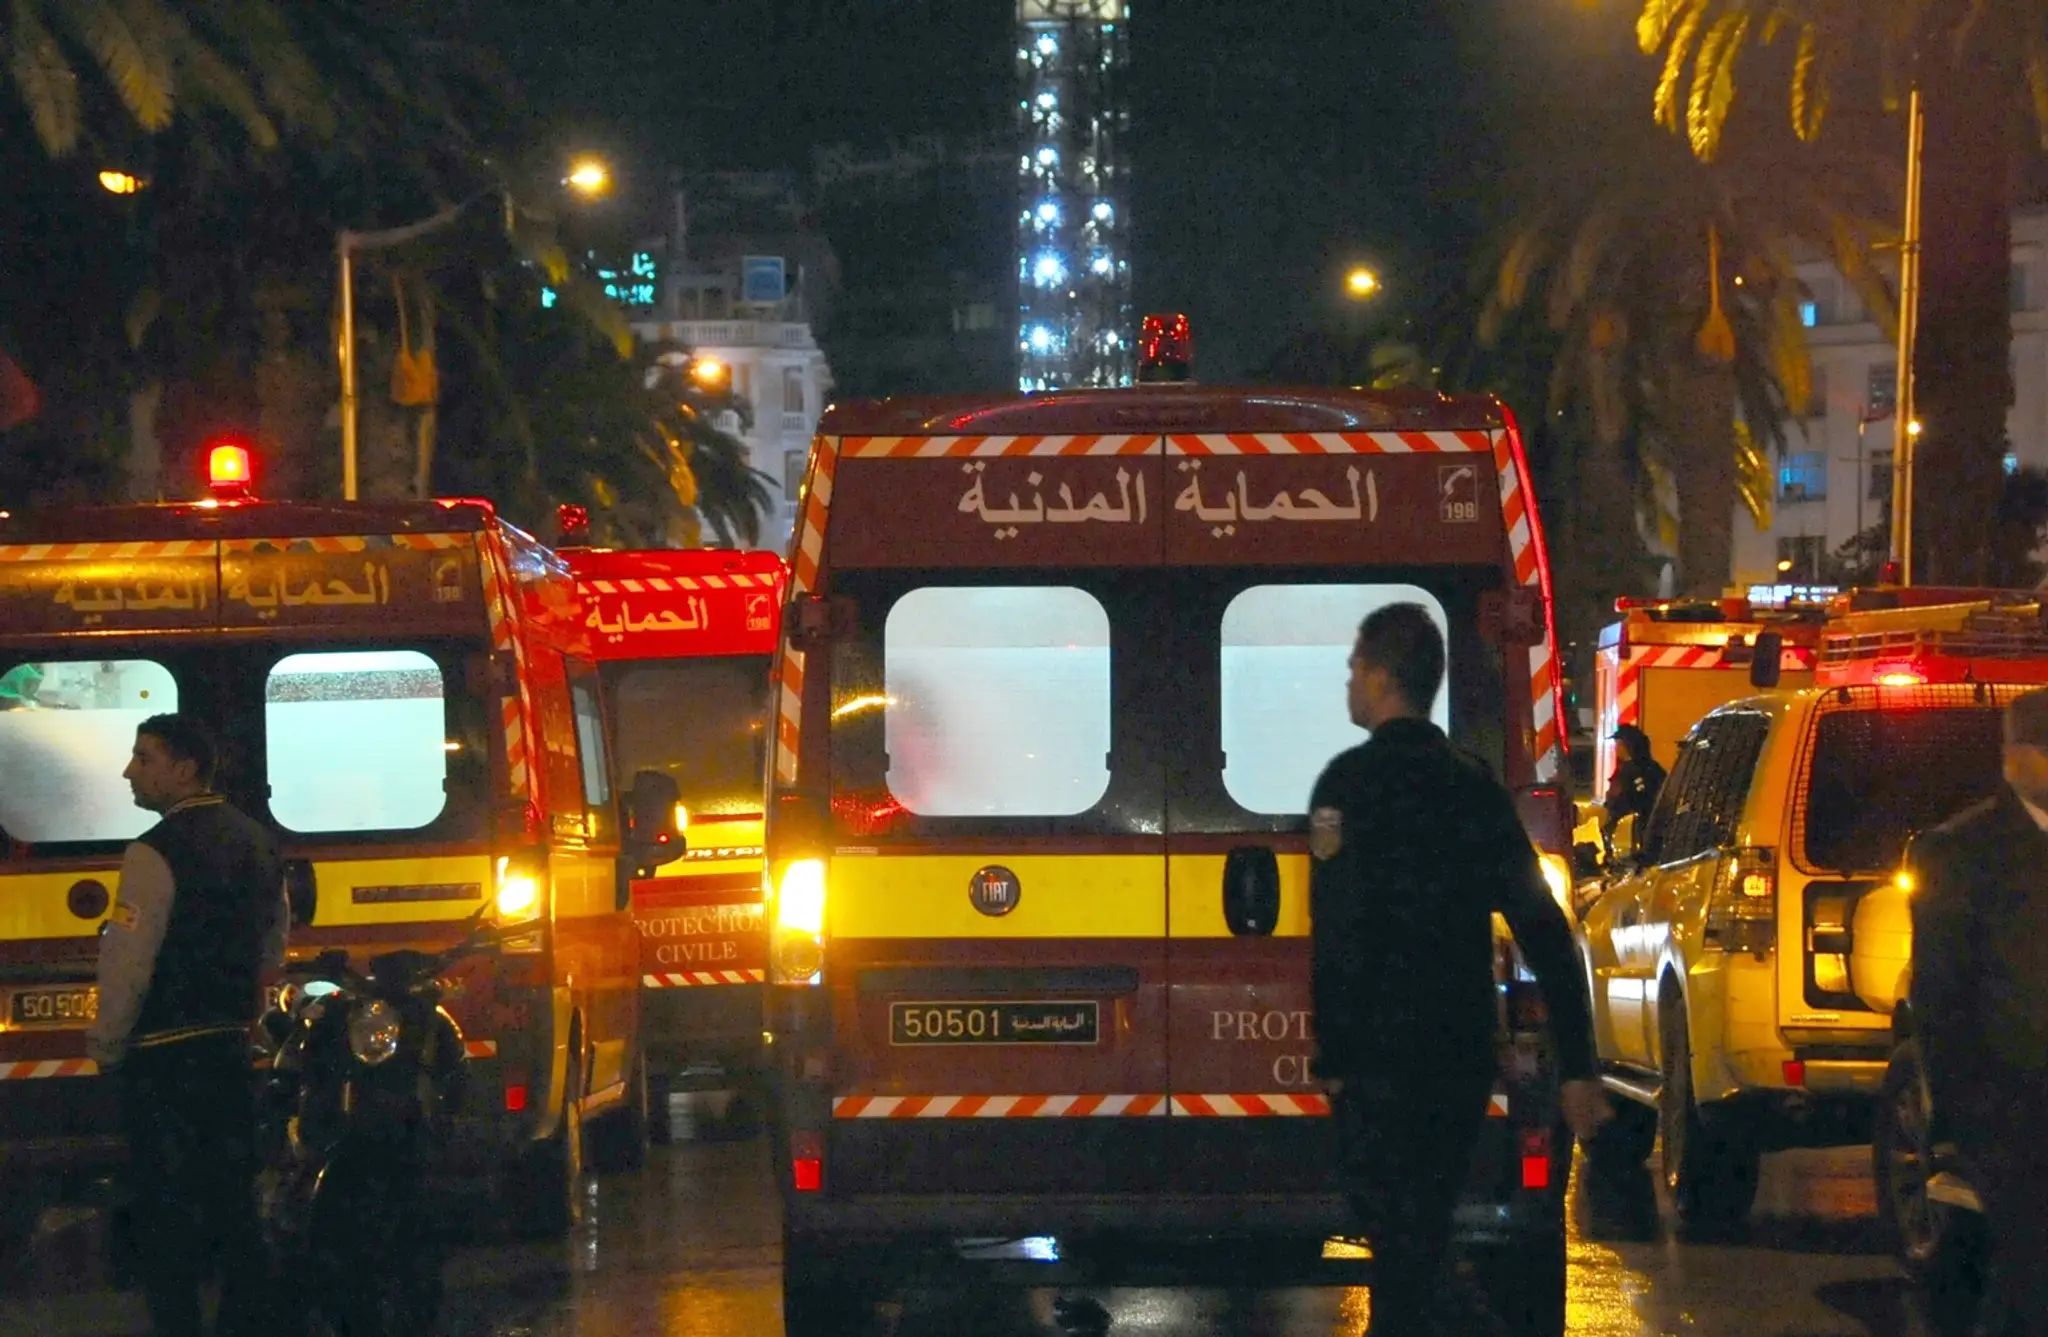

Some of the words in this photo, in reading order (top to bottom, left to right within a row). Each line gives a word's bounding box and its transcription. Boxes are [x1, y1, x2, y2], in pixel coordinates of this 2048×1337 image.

[957, 461, 1148, 540] المدنية
[1174, 459, 1379, 539] الحماية
[1445, 501, 1475, 519] 198
[436, 586, 461, 600] 198
[585, 595, 709, 643] الحماية
[982, 881, 1008, 902] FIAT
[633, 914, 763, 938] ROTECTION
[655, 941, 737, 964] CIVILE
[904, 1008, 1000, 1037] 50501
[1209, 1009, 1315, 1041] PROT
[1272, 1055, 1314, 1086] CI
